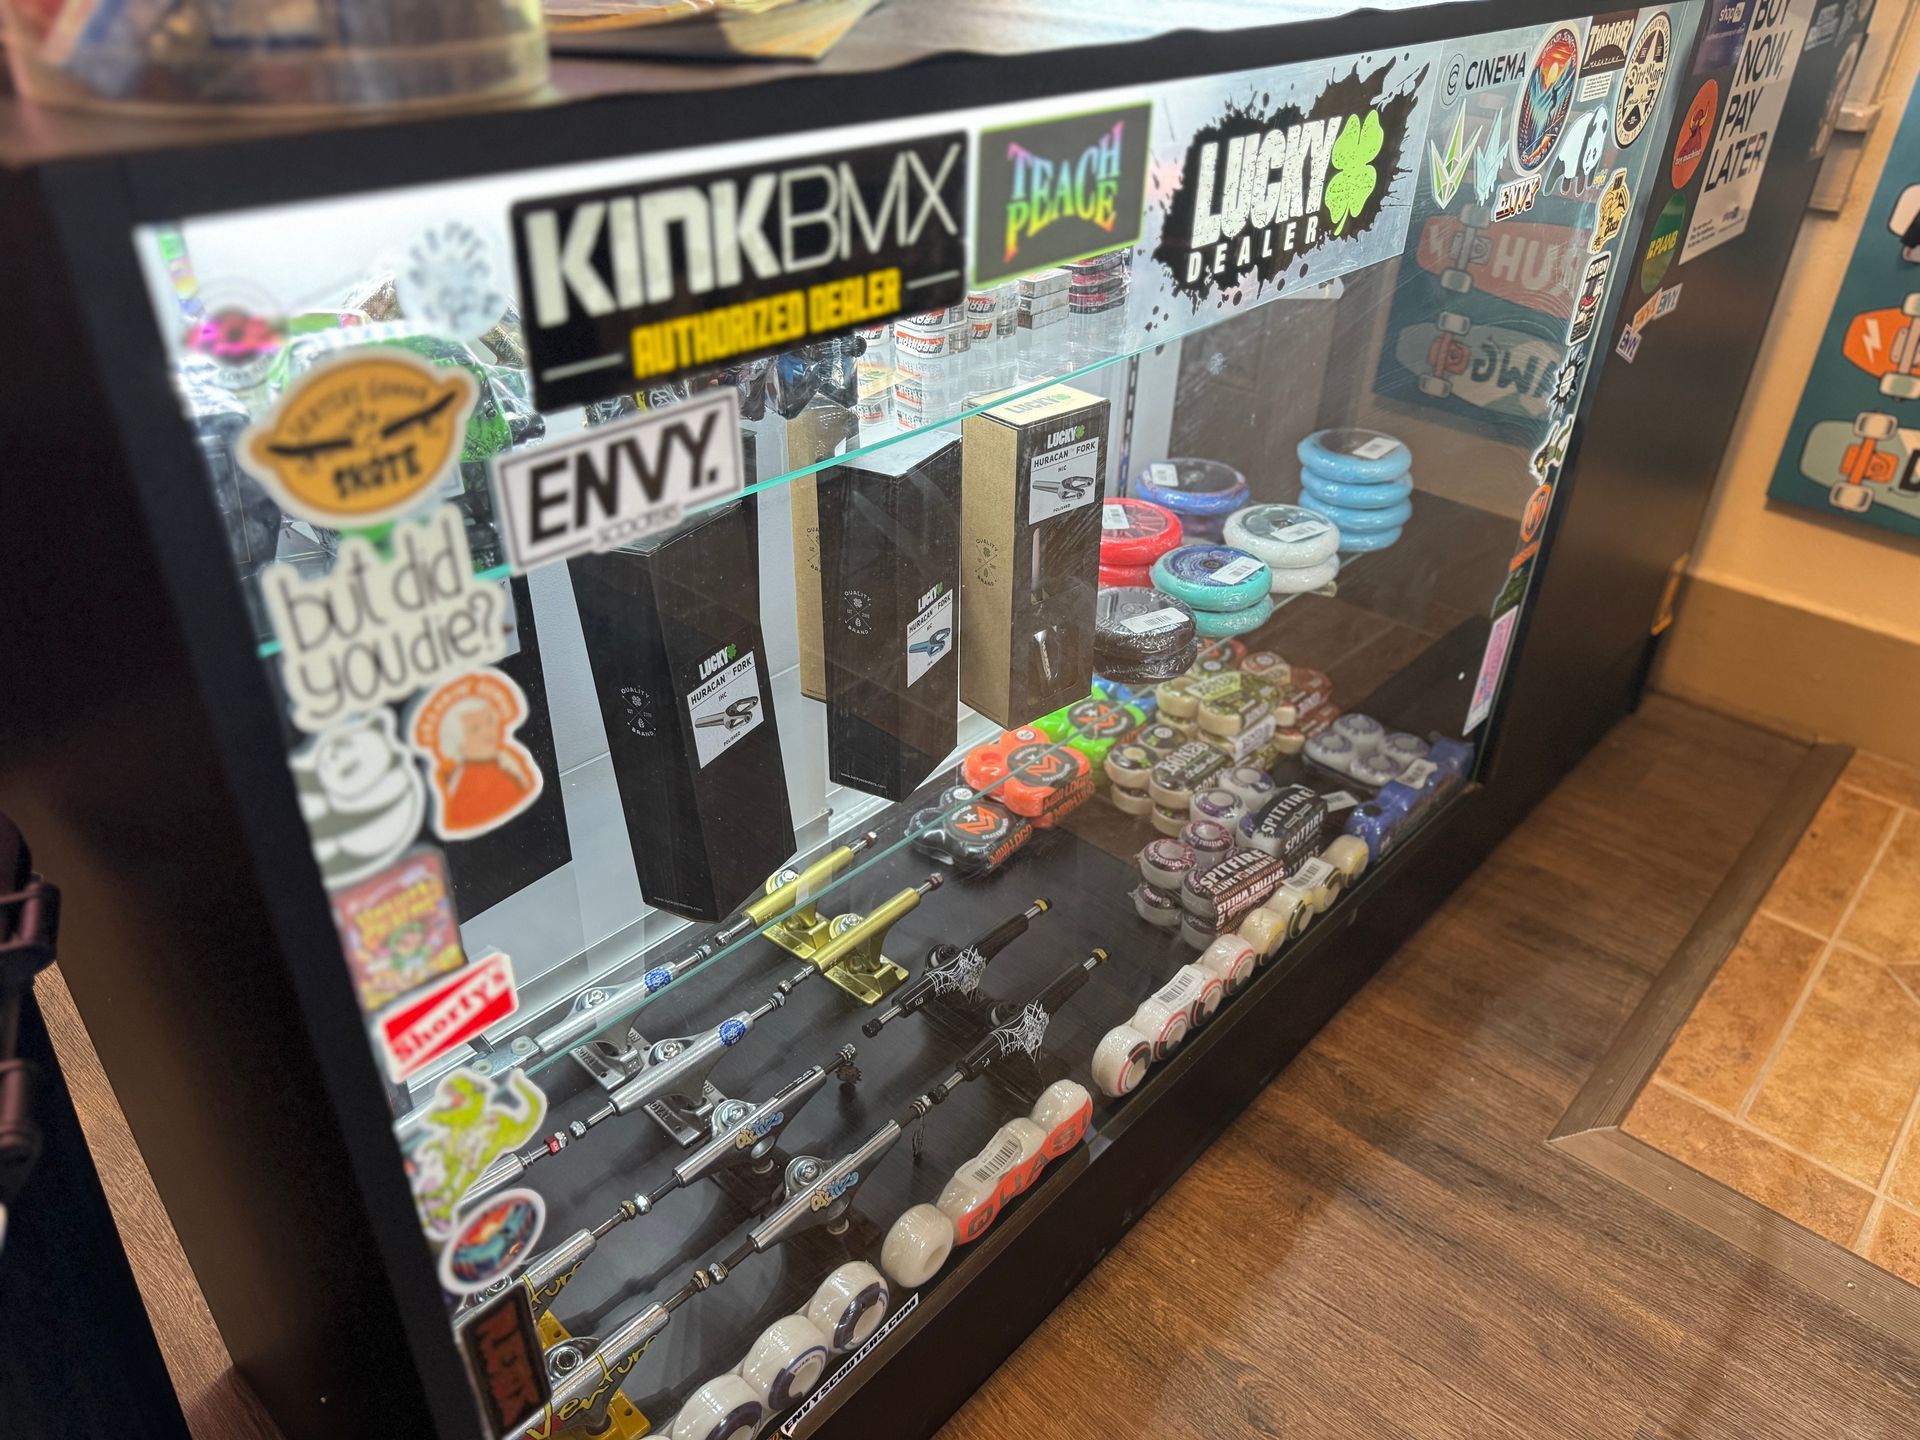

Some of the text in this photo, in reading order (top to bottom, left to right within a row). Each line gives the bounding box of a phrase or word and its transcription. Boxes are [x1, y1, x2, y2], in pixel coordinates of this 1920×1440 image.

[1752, 0, 1791, 31] BUY
[1583, 18, 1634, 66] THRASHER
[1736, 30, 1793, 87] NOW,
[1465, 52, 1526, 90] CINEMA
[1720, 86, 1764, 141] PAY
[1007, 120, 1125, 202] TEACH
[1705, 132, 1767, 193] LATER
[1190, 116, 1343, 250] LUCKY
[1498, 176, 1541, 214] ENVY
[1004, 180, 1119, 263] PEACE
[1187, 216, 1320, 283] DEALER
[1587, 257, 1609, 279] BORN
[630, 267, 901, 380] AUTHORIZED DEALER
[1005, 394, 1056, 414] LUCKY
[1034, 441, 1096, 468] HURACAN FORK
[1047, 426, 1077, 449] LUCKY
[976, 538, 999, 553] QUALITY
[280, 516, 464, 652] but did
[844, 590, 872, 602] QUALITY
[847, 625, 869, 635] BRAND
[908, 594, 952, 634] HURACAN FORK
[301, 637, 410, 719] you
[411, 589, 496, 675] die?
[699, 646, 729, 680] LUCKY
[620, 686, 650, 699] QUALITY
[690, 657, 752, 705] HURACAN FORK
[631, 727, 655, 737] BRAND
[723, 731, 741, 747] POLISHED
[1158, 740, 1210, 776] BONES
[1261, 789, 1315, 835] SPITFIRE
[1284, 810, 1324, 855] SPITFIRE
[1200, 848, 1266, 891] SPITFIRE
[1218, 878, 1237, 893] LIVE
[1246, 855, 1271, 876] BURN
[1250, 867, 1285, 896] SPITFIRE
[1217, 891, 1249, 915] WHEELS
[392, 966, 506, 1062] Shorty's
[784, 1297, 917, 1433] ENVYSCOOTERS.COM
